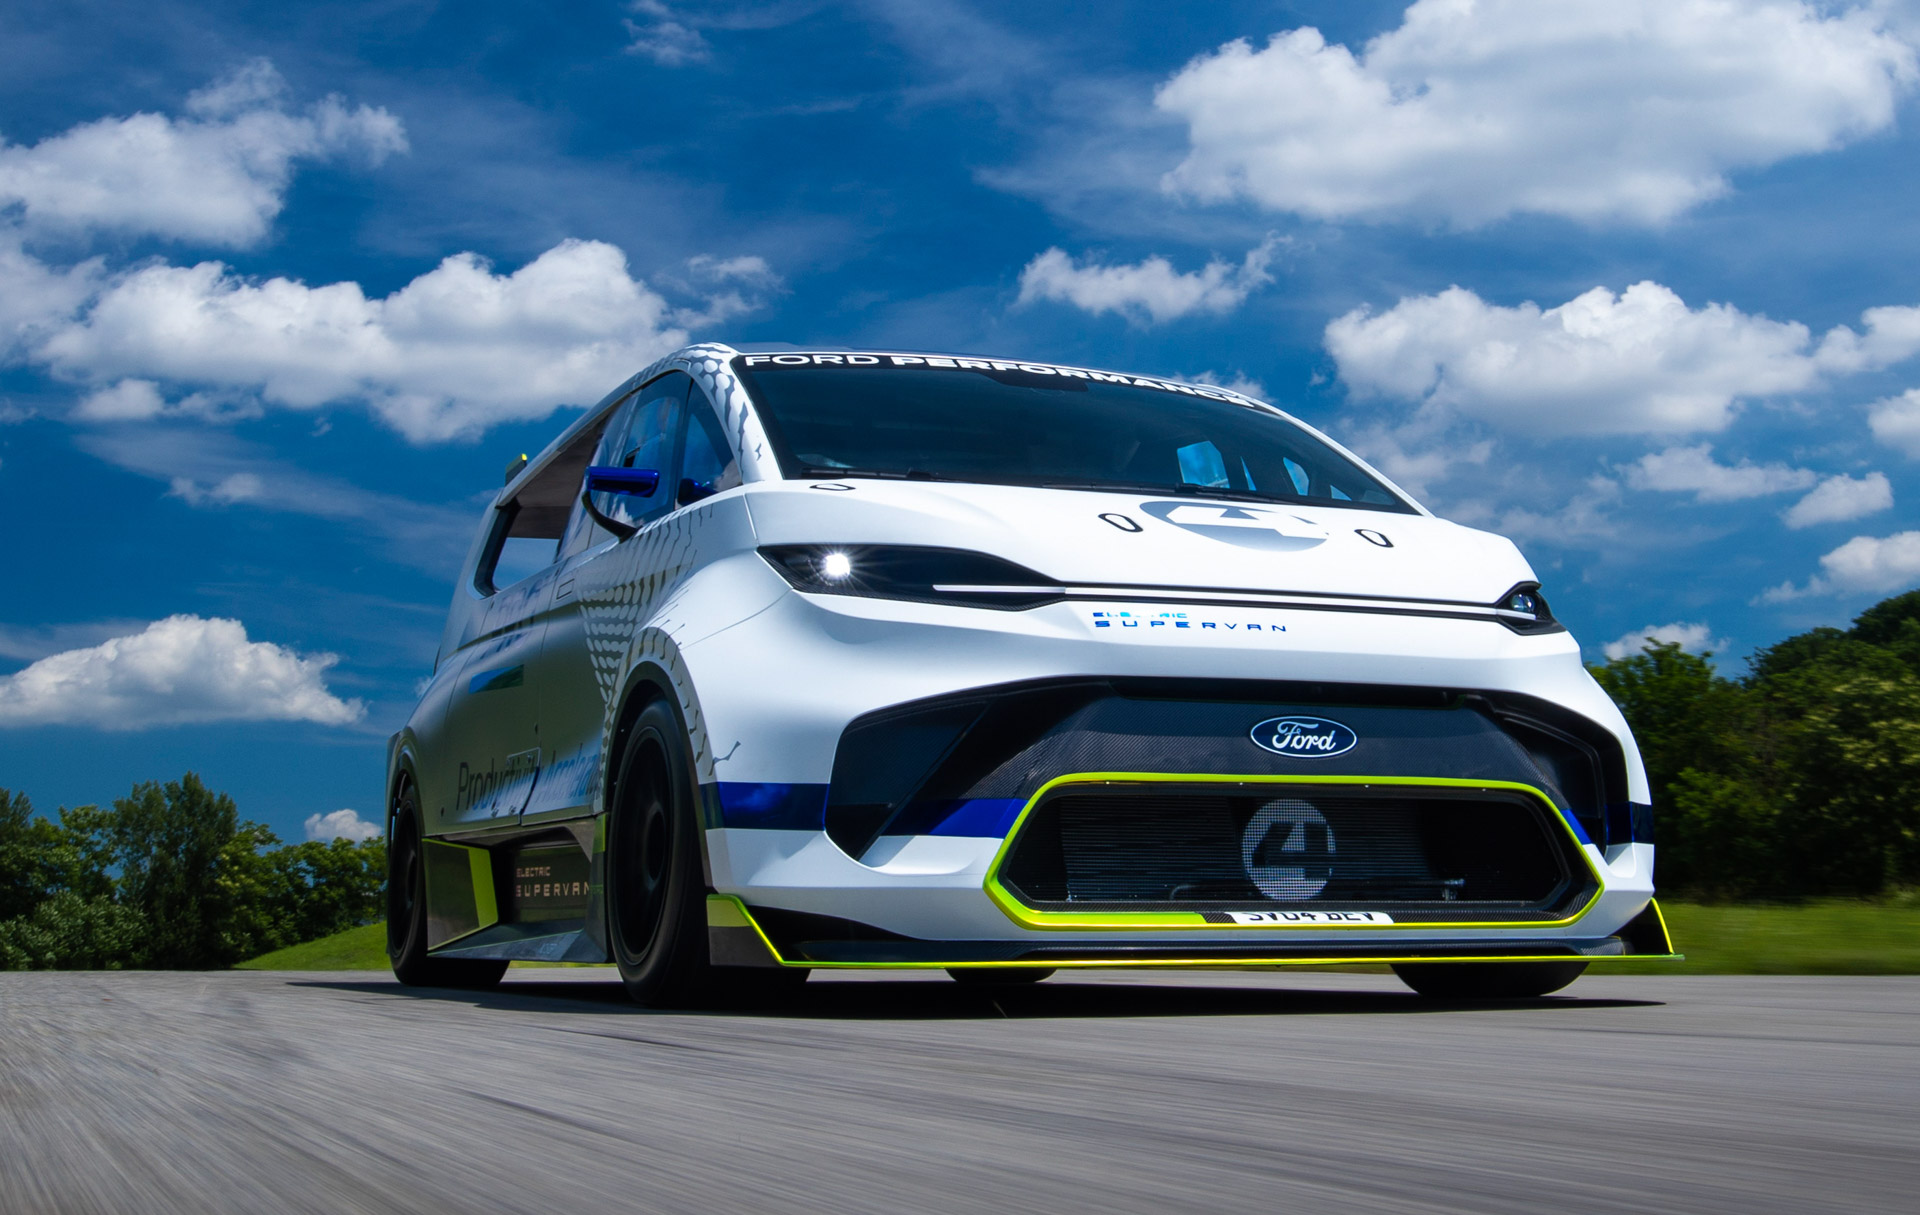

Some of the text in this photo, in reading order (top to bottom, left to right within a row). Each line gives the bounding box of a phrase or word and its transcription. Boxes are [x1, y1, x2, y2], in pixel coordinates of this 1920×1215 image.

[745, 355, 1254, 408] FORD PERFORMANCE
[1094, 620, 1287, 632] SUPERVAN
[1272, 721, 1336, 750] Ford
[516, 866, 551, 878] ELECTRIC
[516, 881, 590, 897] SUPERVAN
